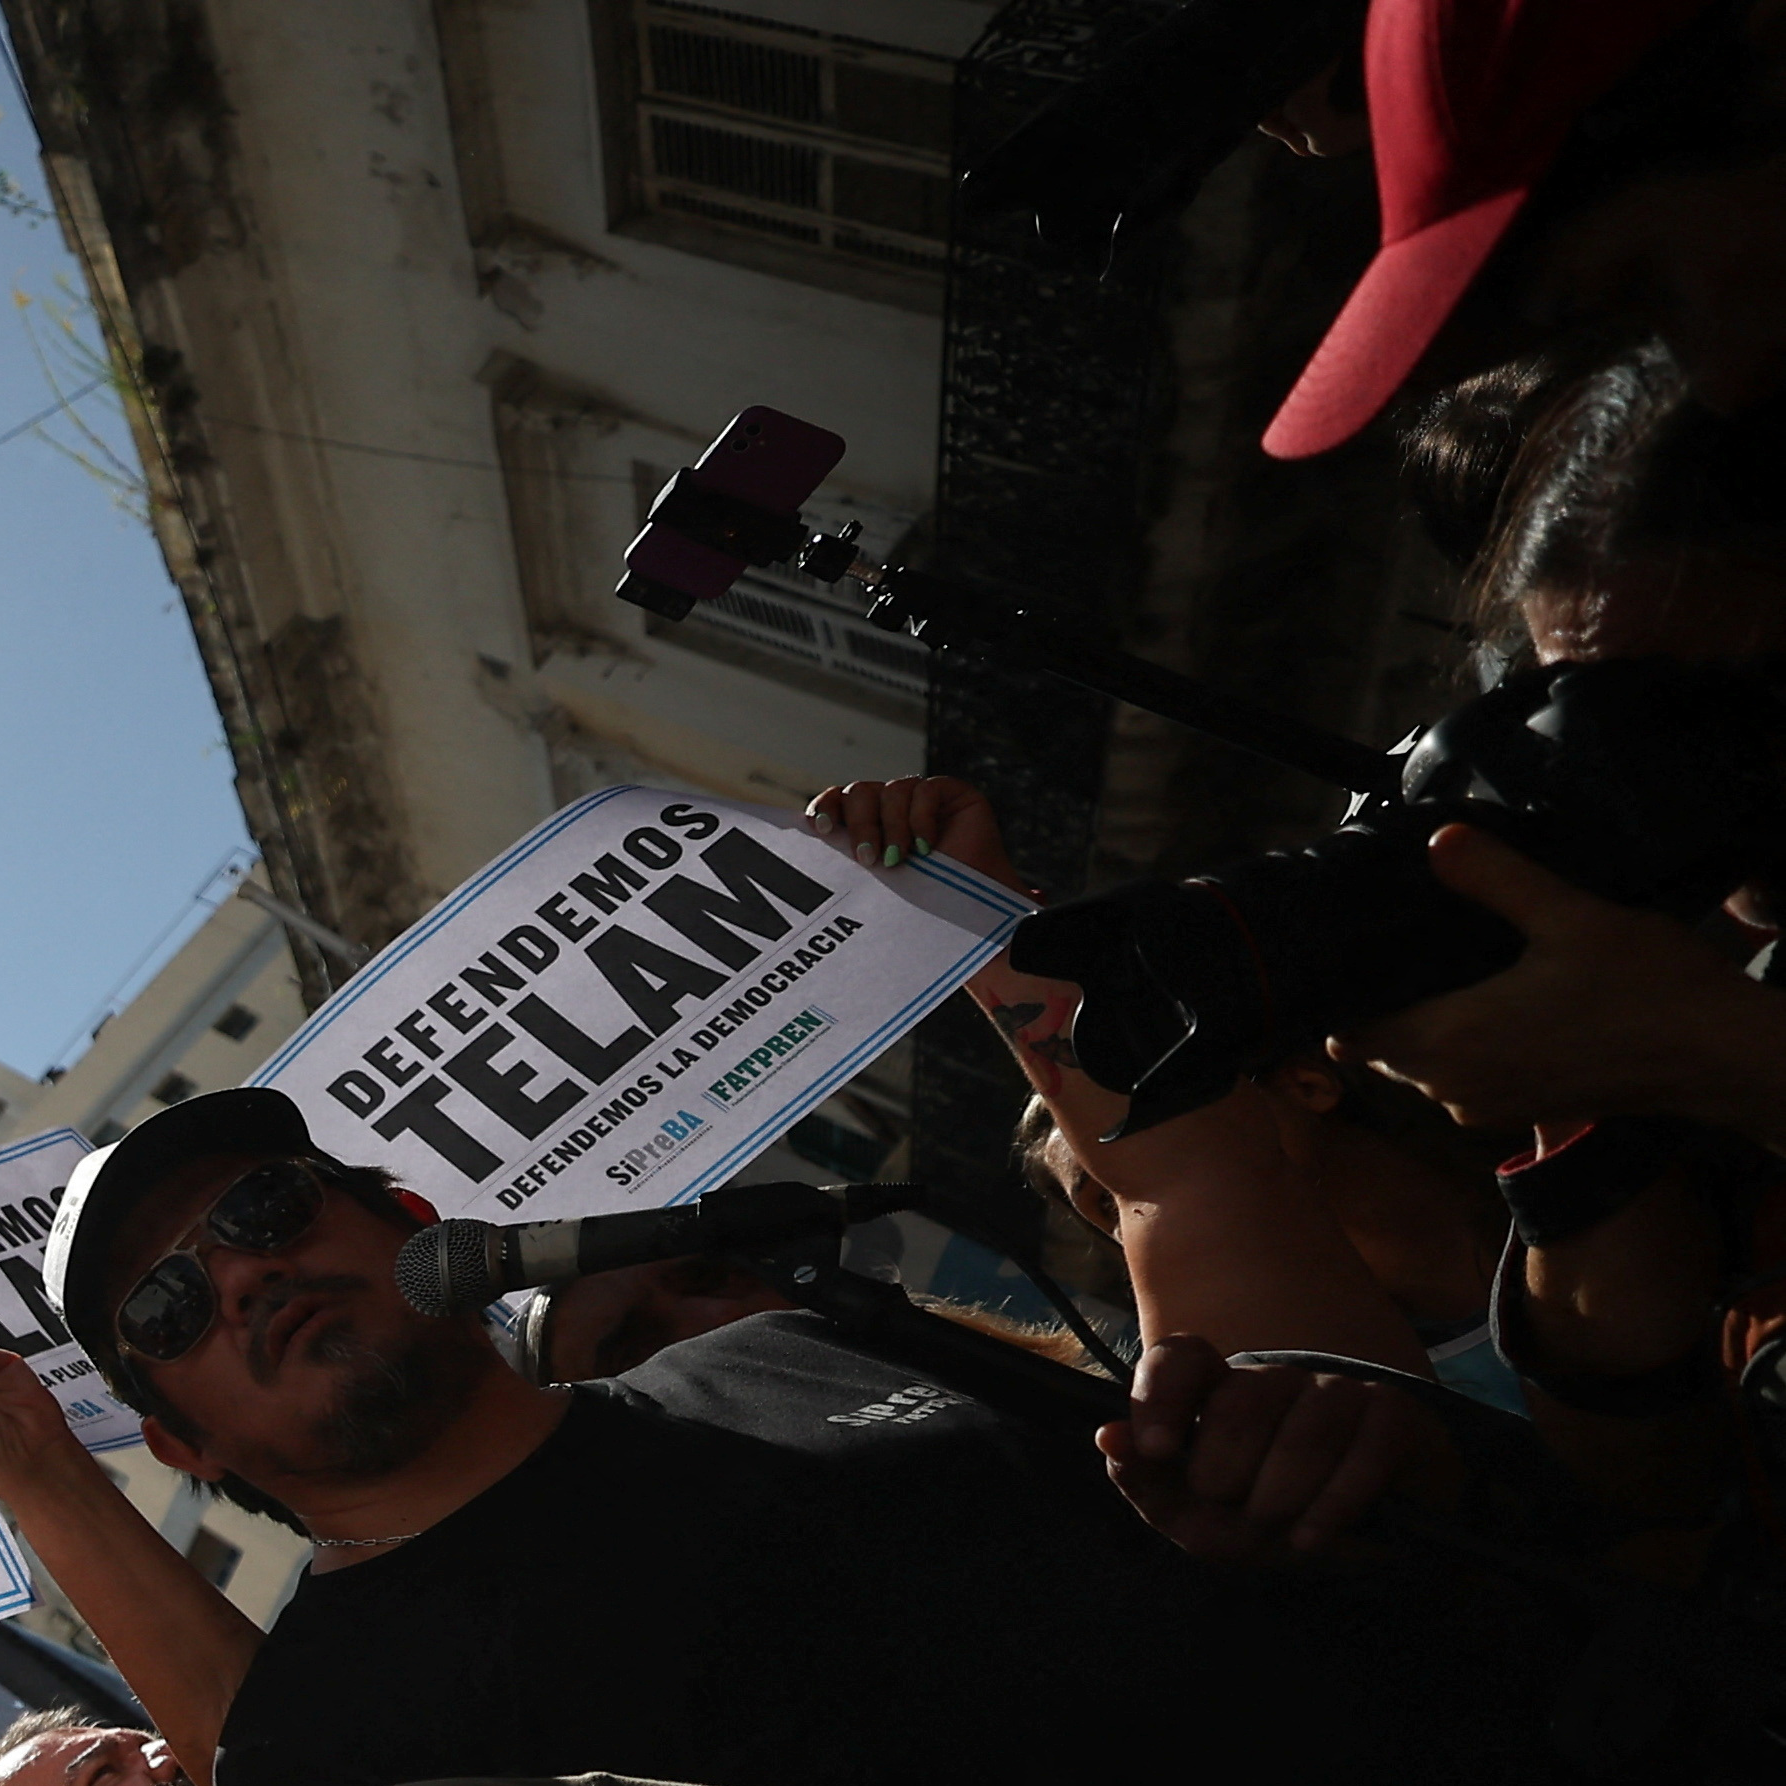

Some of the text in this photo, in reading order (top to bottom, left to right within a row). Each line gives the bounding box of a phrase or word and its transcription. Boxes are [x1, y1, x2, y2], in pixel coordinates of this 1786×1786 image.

[326, 801, 720, 1120] DEFENDEMOS
[370, 826, 835, 1185] TELAM
[708, 1010, 824, 1101] FATPREN
[496, 1073, 664, 1211] DEFENDEMOS
[656, 1047, 700, 1080] LA
[690, 914, 864, 1052] DEMOCRACIA
[606, 1110, 704, 1186] SiPreBA
[39, 1373, 57, 1387] A
